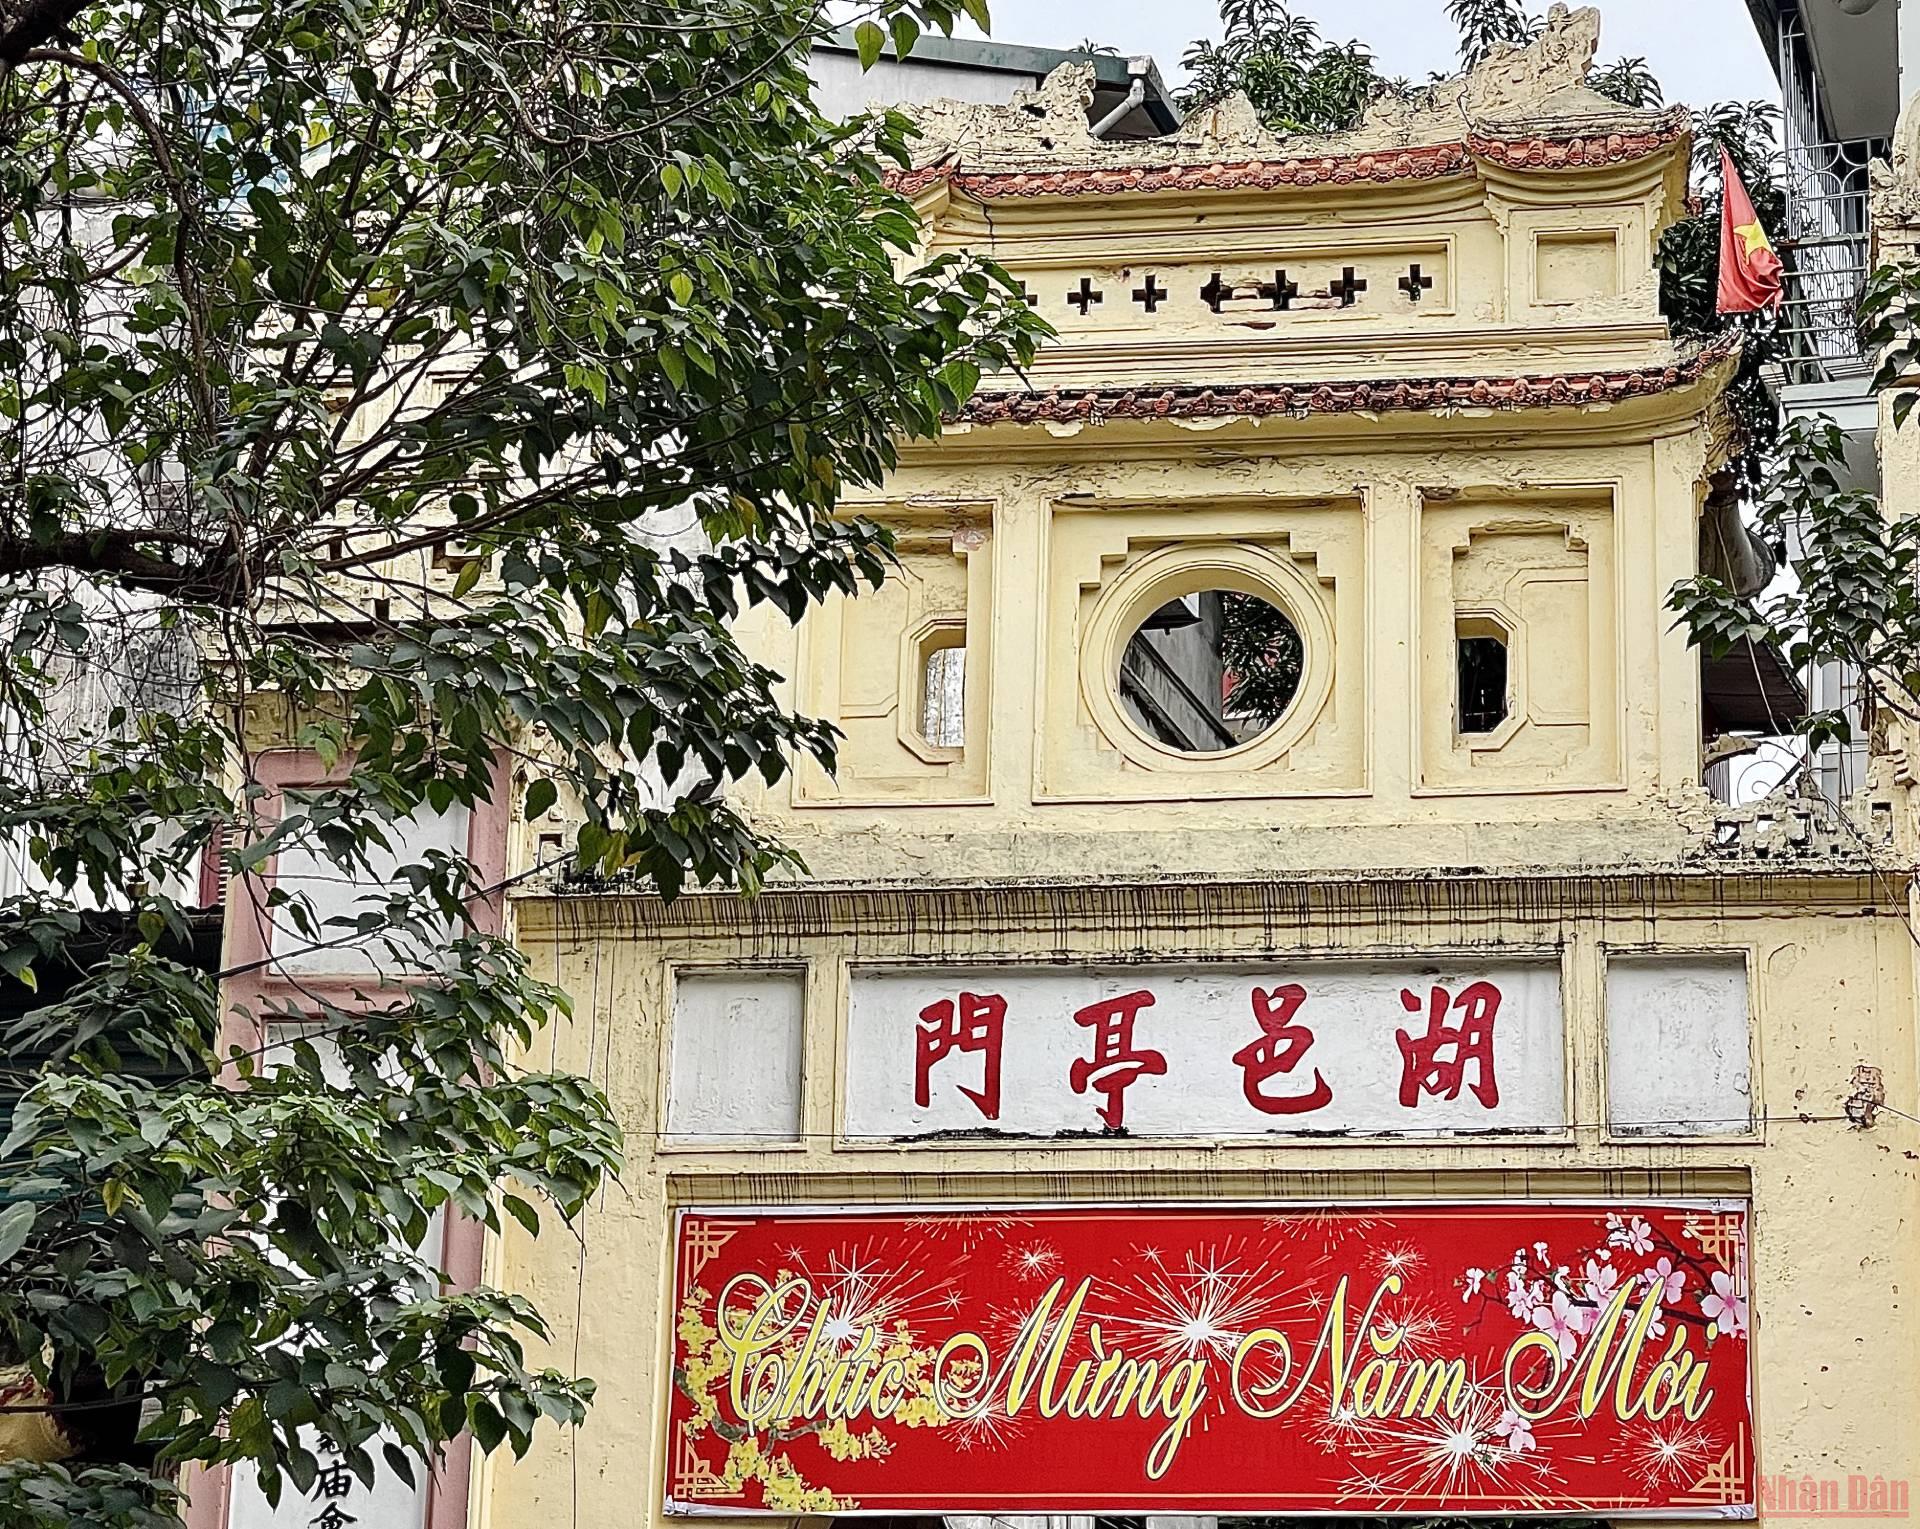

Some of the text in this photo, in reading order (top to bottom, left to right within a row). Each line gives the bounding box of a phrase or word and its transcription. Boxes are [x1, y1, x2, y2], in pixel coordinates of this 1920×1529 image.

[717, 1272, 1719, 1480] Chúc Mừng Năm Mới
